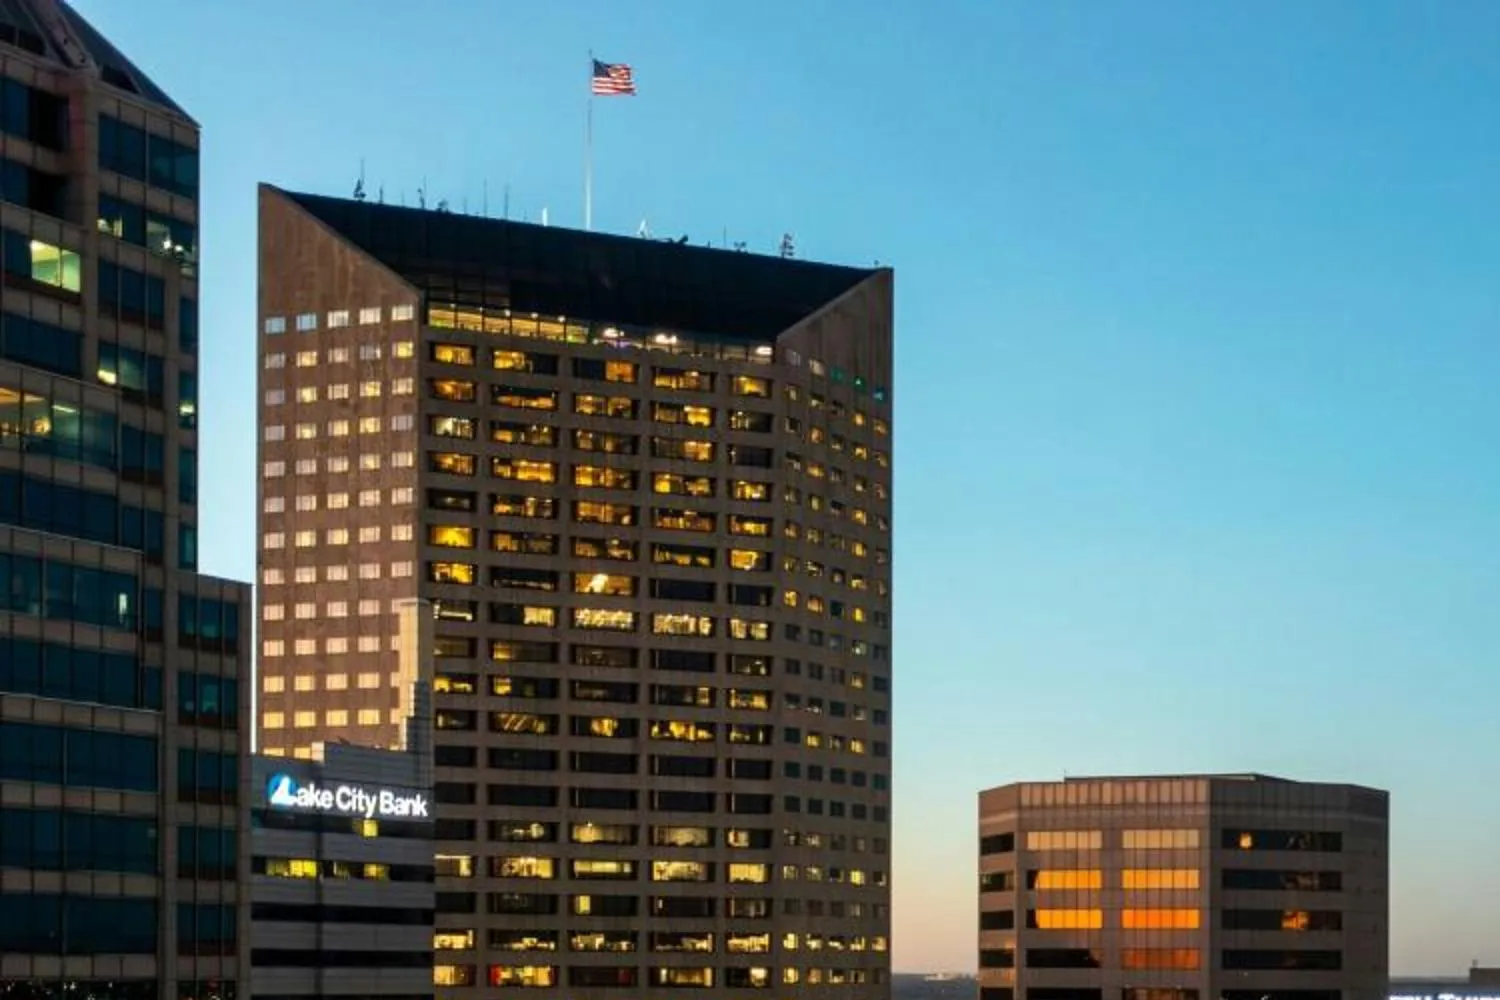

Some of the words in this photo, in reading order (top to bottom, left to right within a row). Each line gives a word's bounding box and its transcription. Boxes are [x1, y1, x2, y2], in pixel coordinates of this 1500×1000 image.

[271, 775, 333, 809] Lake
[335, 784, 376, 818] City
[379, 788, 428, 817] Bank
